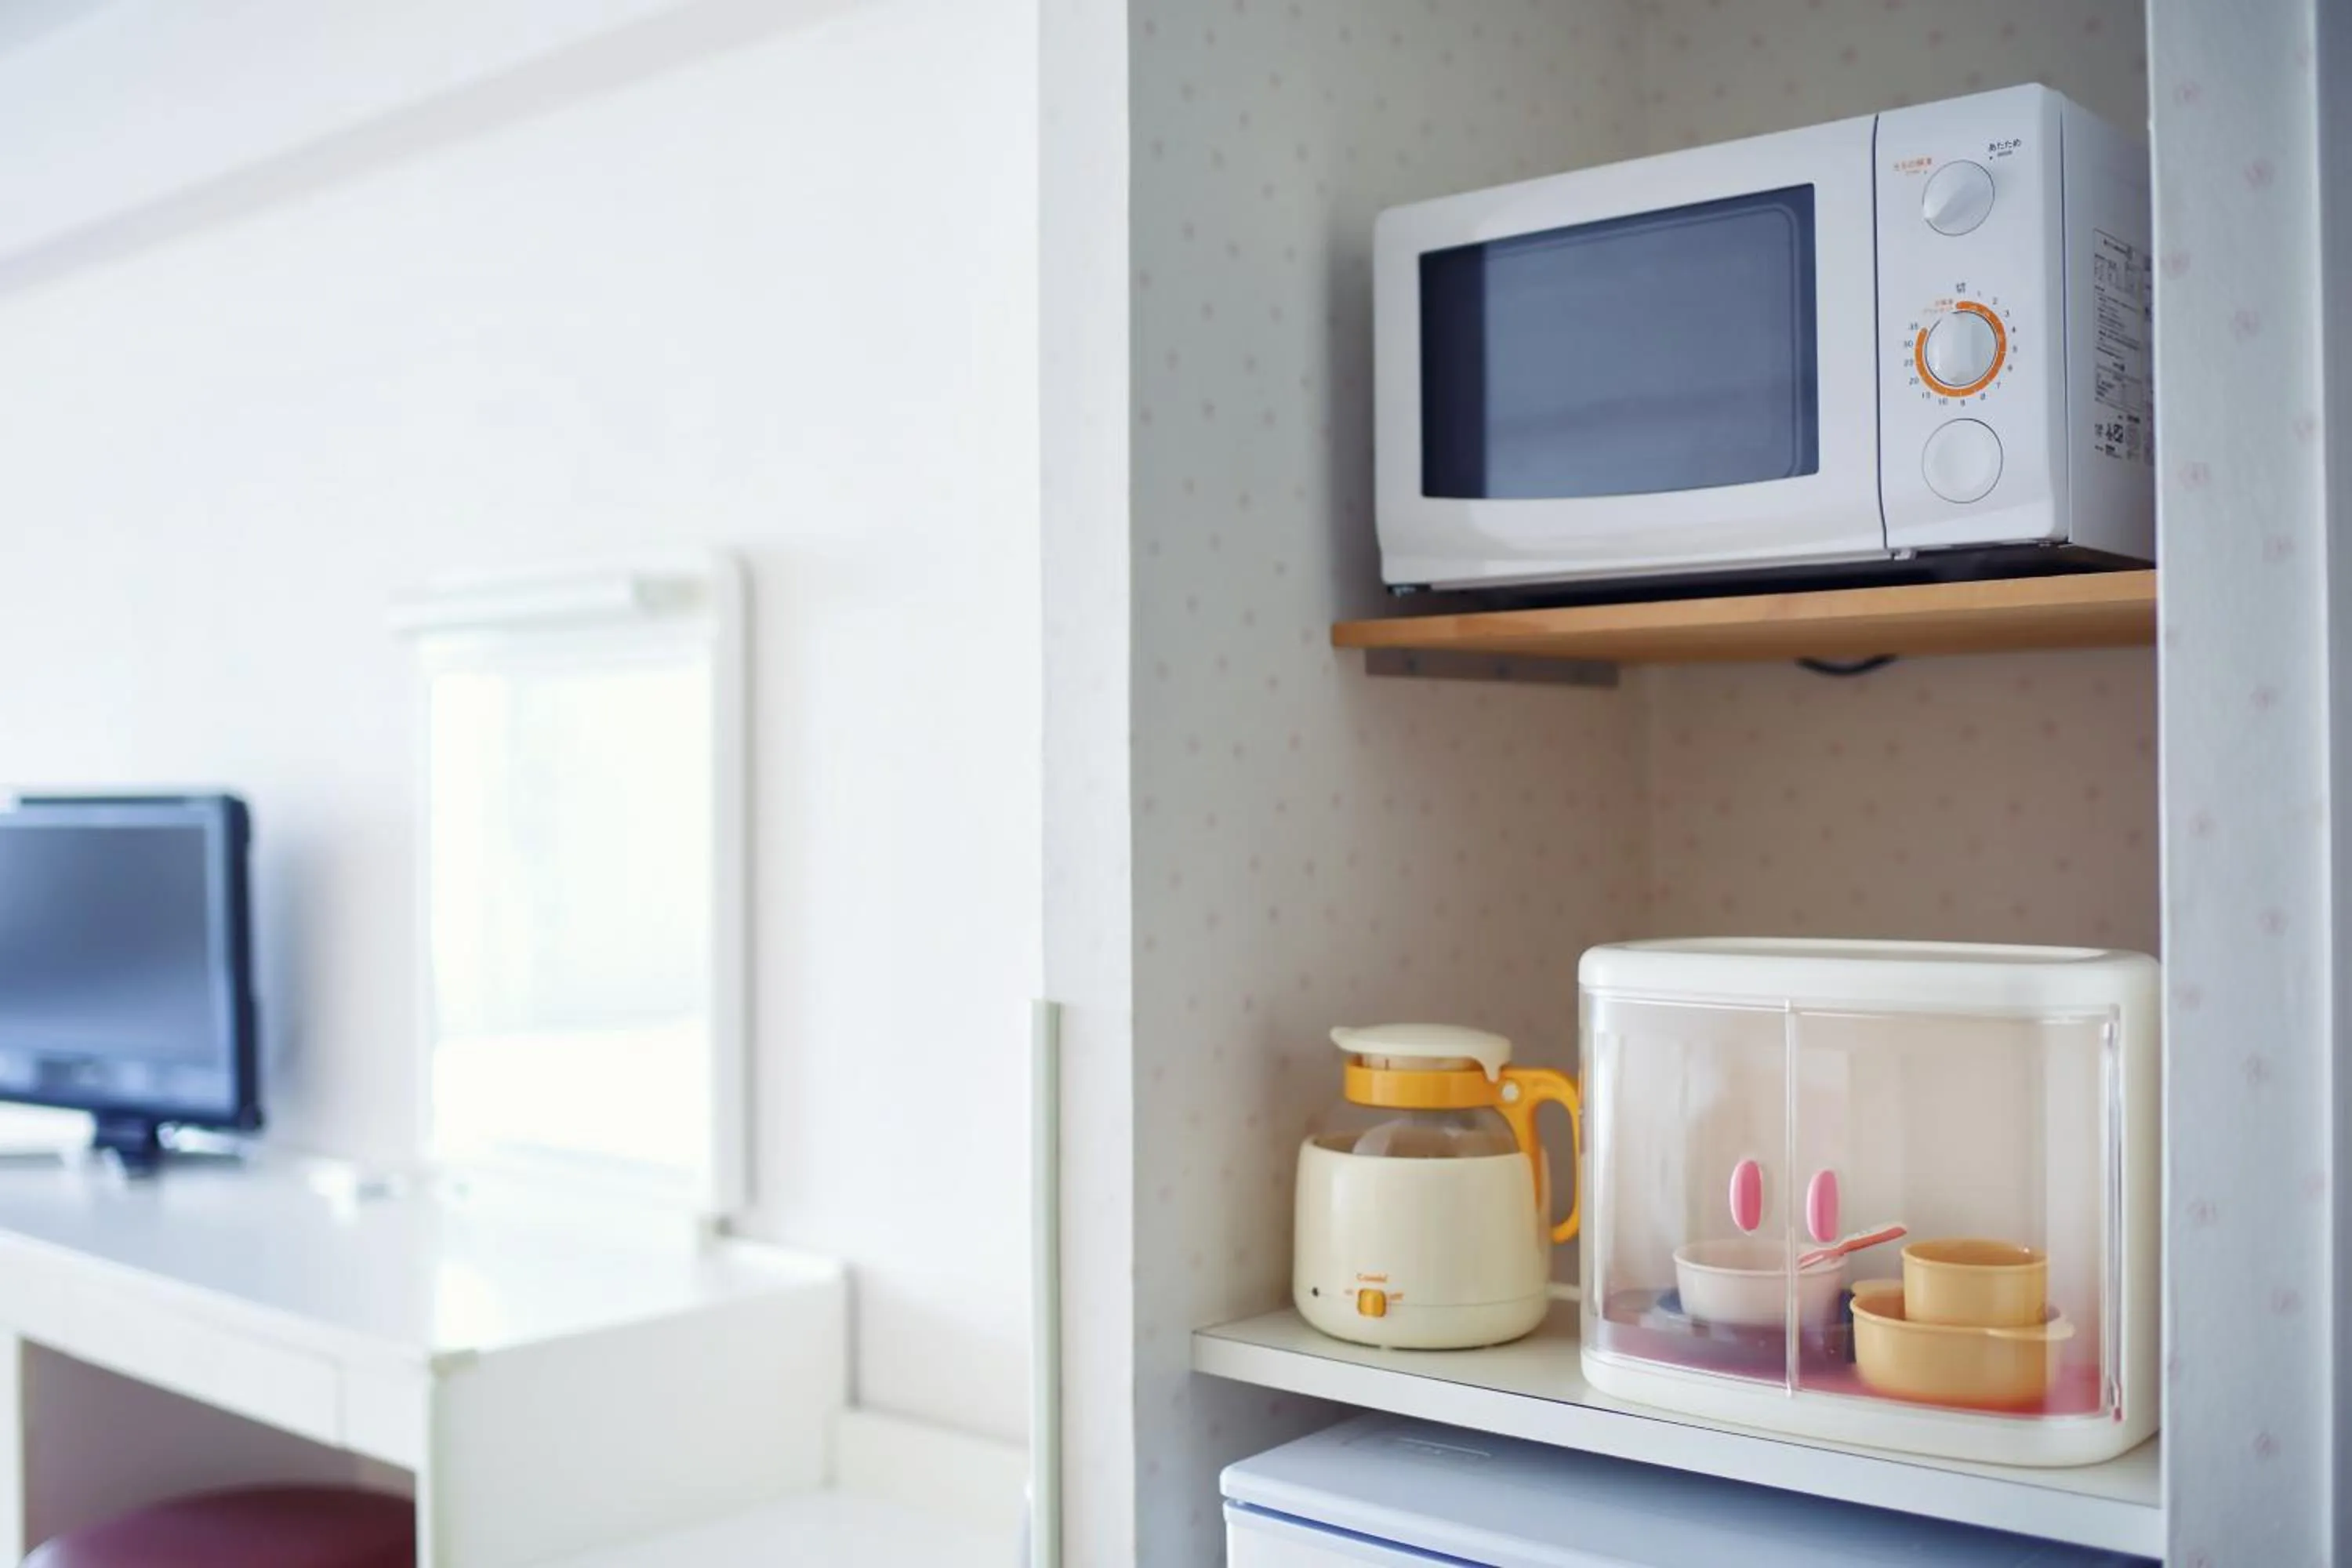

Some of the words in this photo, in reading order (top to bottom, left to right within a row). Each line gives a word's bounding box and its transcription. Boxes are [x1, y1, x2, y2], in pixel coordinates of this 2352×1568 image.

[1988, 138, 2021, 151] あたため
[1908, 376, 1919, 385] 20
